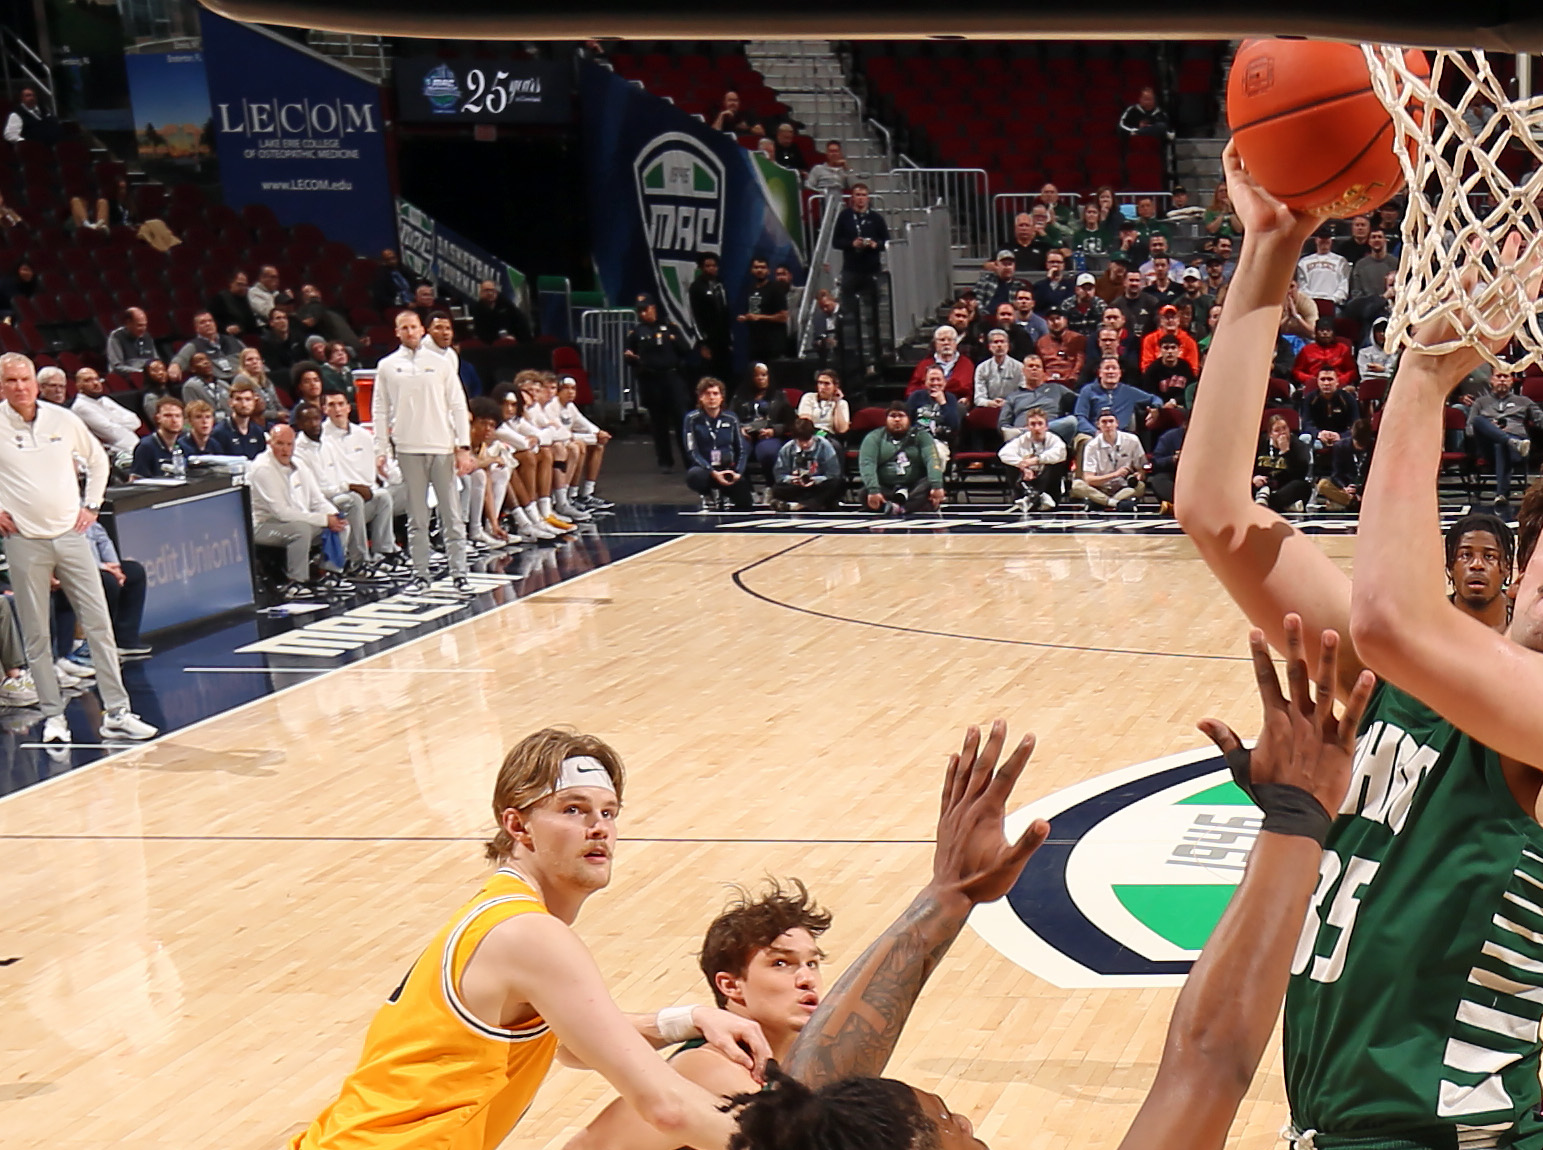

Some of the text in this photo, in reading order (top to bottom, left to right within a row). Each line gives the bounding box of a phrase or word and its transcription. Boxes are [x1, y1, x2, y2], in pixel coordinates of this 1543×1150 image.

[461, 69, 509, 113] 25
[244, 150, 359, 159] OF OSTEOPATHIC MEDICINE
[258, 139, 340, 148] LAKE ERIE COLLEGE
[261, 180, 352, 190] www.LECOM.edu
[650, 203, 721, 257] MAC
[181, 533, 233, 577] Union
[1165, 813, 1263, 871] 1946
